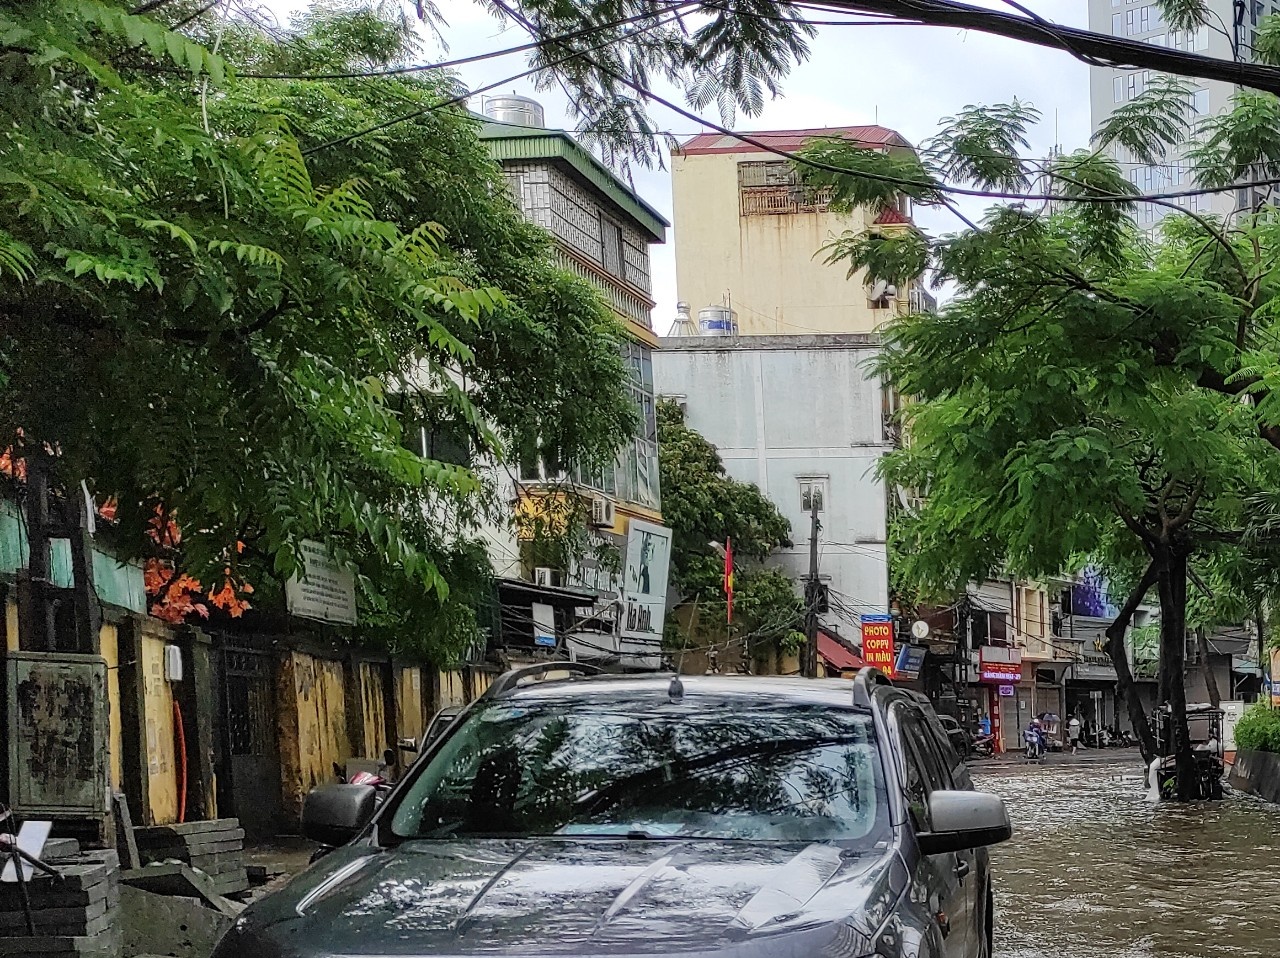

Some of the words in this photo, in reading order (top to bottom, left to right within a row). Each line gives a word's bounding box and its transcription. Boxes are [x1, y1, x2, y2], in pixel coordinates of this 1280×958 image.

[864, 626, 889, 636] PHOTO
[866, 639, 889, 649] COPPY
[866, 653, 874, 662] IN
[875, 650, 891, 662] MÀU
